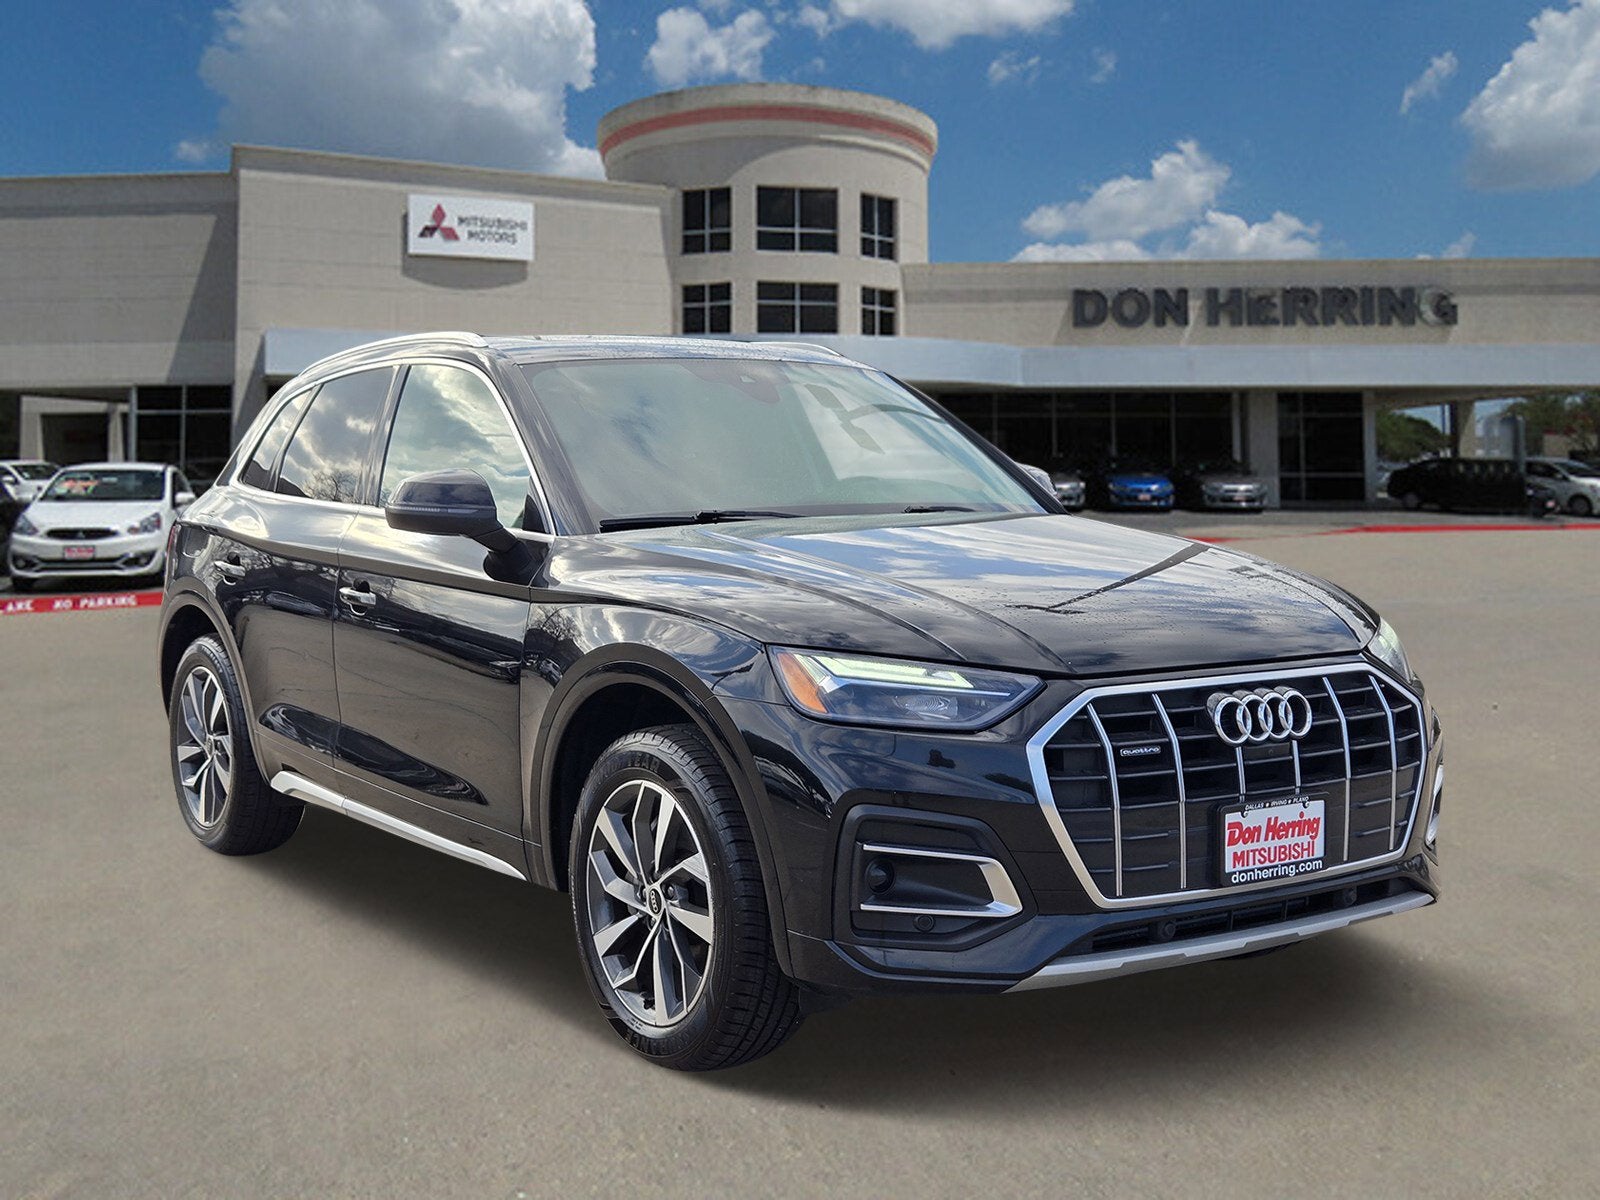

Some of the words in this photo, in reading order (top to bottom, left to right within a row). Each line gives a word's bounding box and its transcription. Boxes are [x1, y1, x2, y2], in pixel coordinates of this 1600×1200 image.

[1072, 287, 1189, 328] DON
[1205, 286, 1458, 327] HERRING
[53, 599, 73, 609] NO
[79, 594, 137, 609] PARKING
[1122, 747, 1160, 755] quattro
[1244, 802, 1265, 811] DALLAS
[1270, 798, 1288, 807] IRVING
[1227, 821, 1262, 847] Don
[1264, 811, 1321, 841] Herring
[1232, 841, 1315, 869] MITSUBISHI
[1231, 859, 1323, 884] donherring.com
